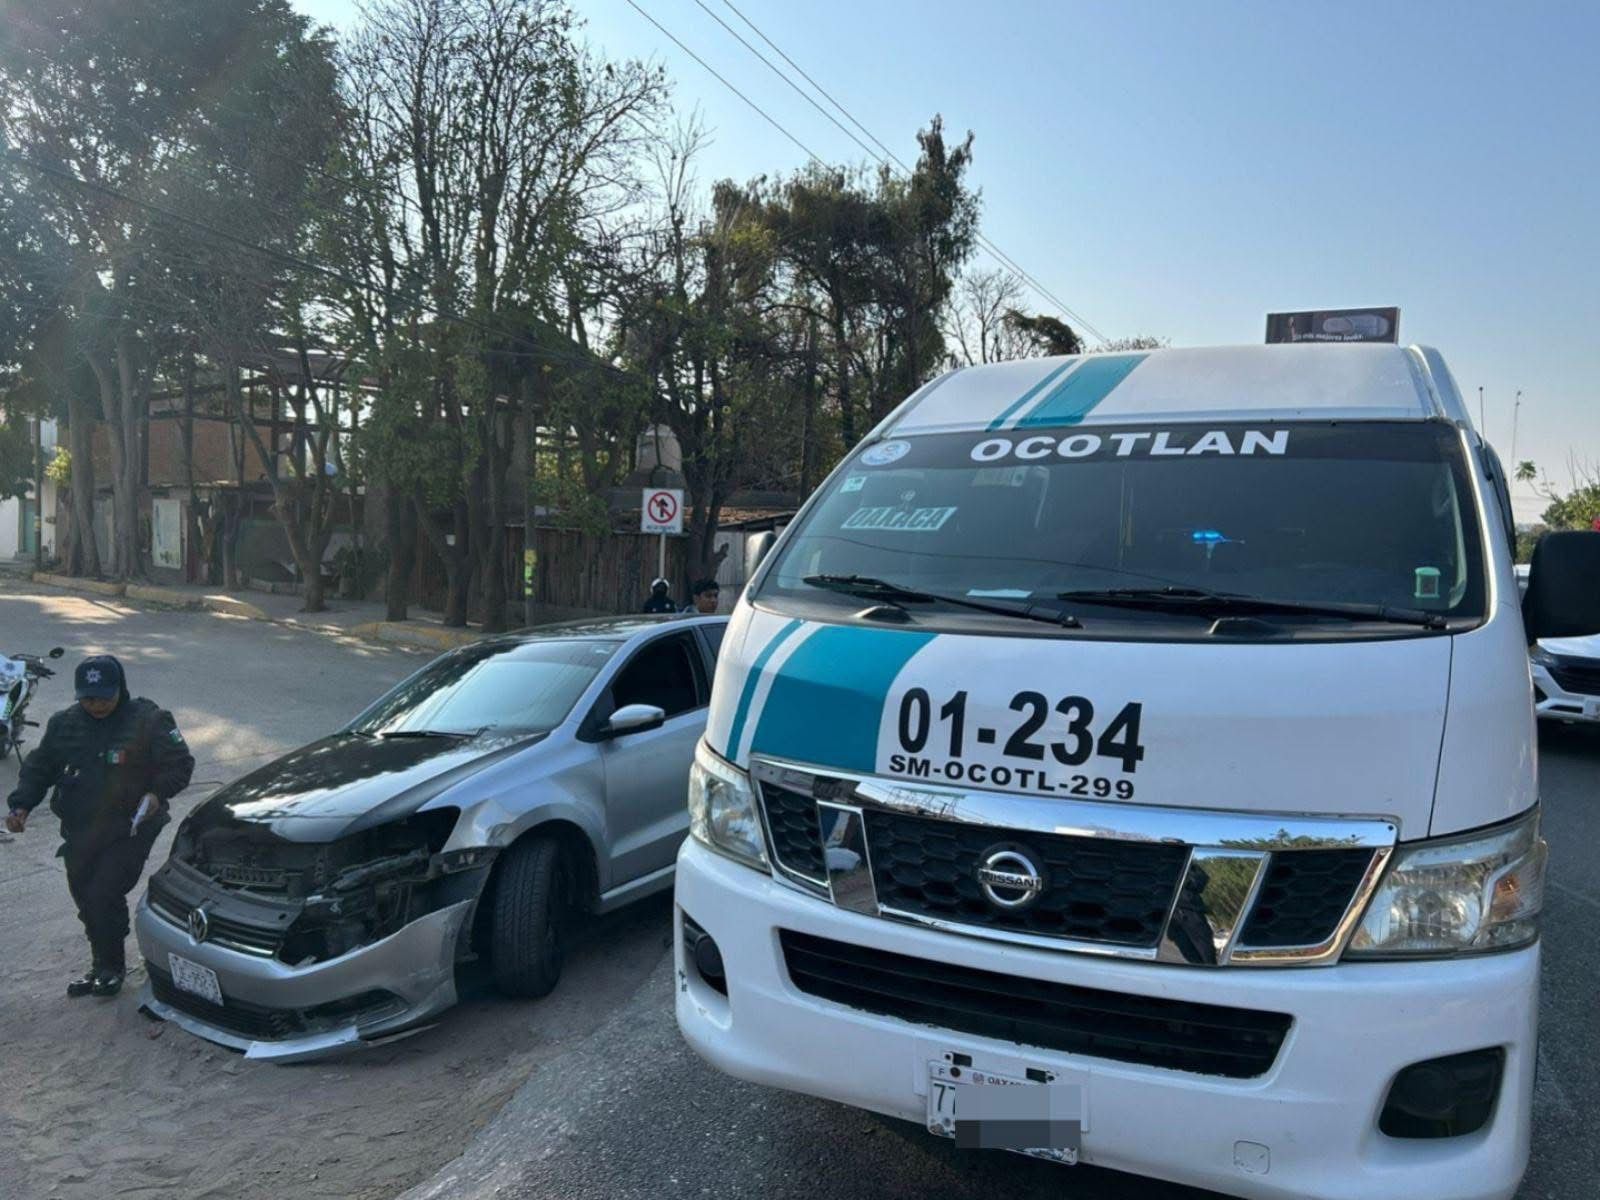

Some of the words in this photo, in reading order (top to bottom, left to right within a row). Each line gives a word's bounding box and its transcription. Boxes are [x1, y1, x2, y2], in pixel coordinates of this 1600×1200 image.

[970, 431, 1290, 461] OCOTLAN
[898, 687, 1144, 773] 01-234
[889, 754, 1134, 800] SM-OCOTL-299
[982, 871, 1035, 888] NISSAN
